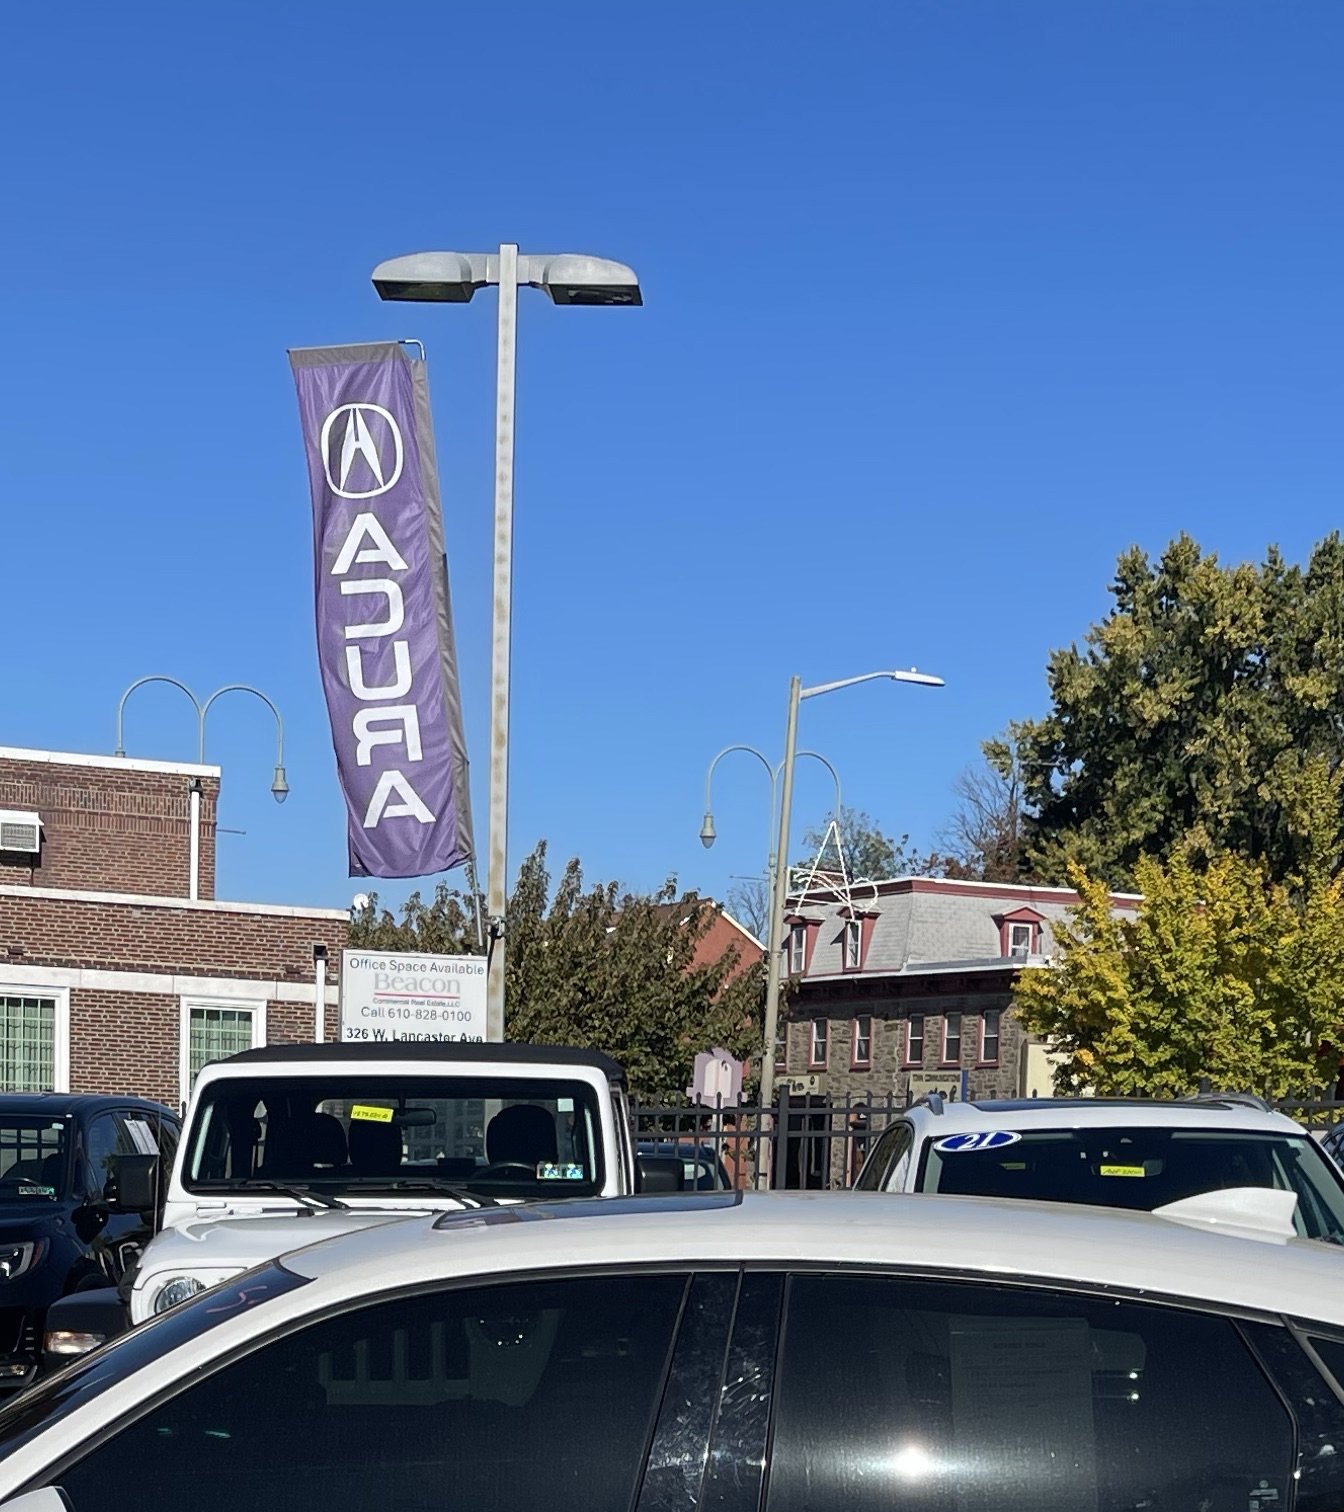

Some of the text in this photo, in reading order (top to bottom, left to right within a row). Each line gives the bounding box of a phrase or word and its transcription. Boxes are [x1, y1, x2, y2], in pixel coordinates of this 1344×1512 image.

[349, 958, 485, 975] Office Space Available
[374, 972, 461, 994] Beacon
[361, 1006, 472, 1022] Call 610-828-0100
[346, 1027, 369, 1040] 326
[392, 1029, 457, 1042] Lancaster
[957, 1132, 996, 1150] 21
